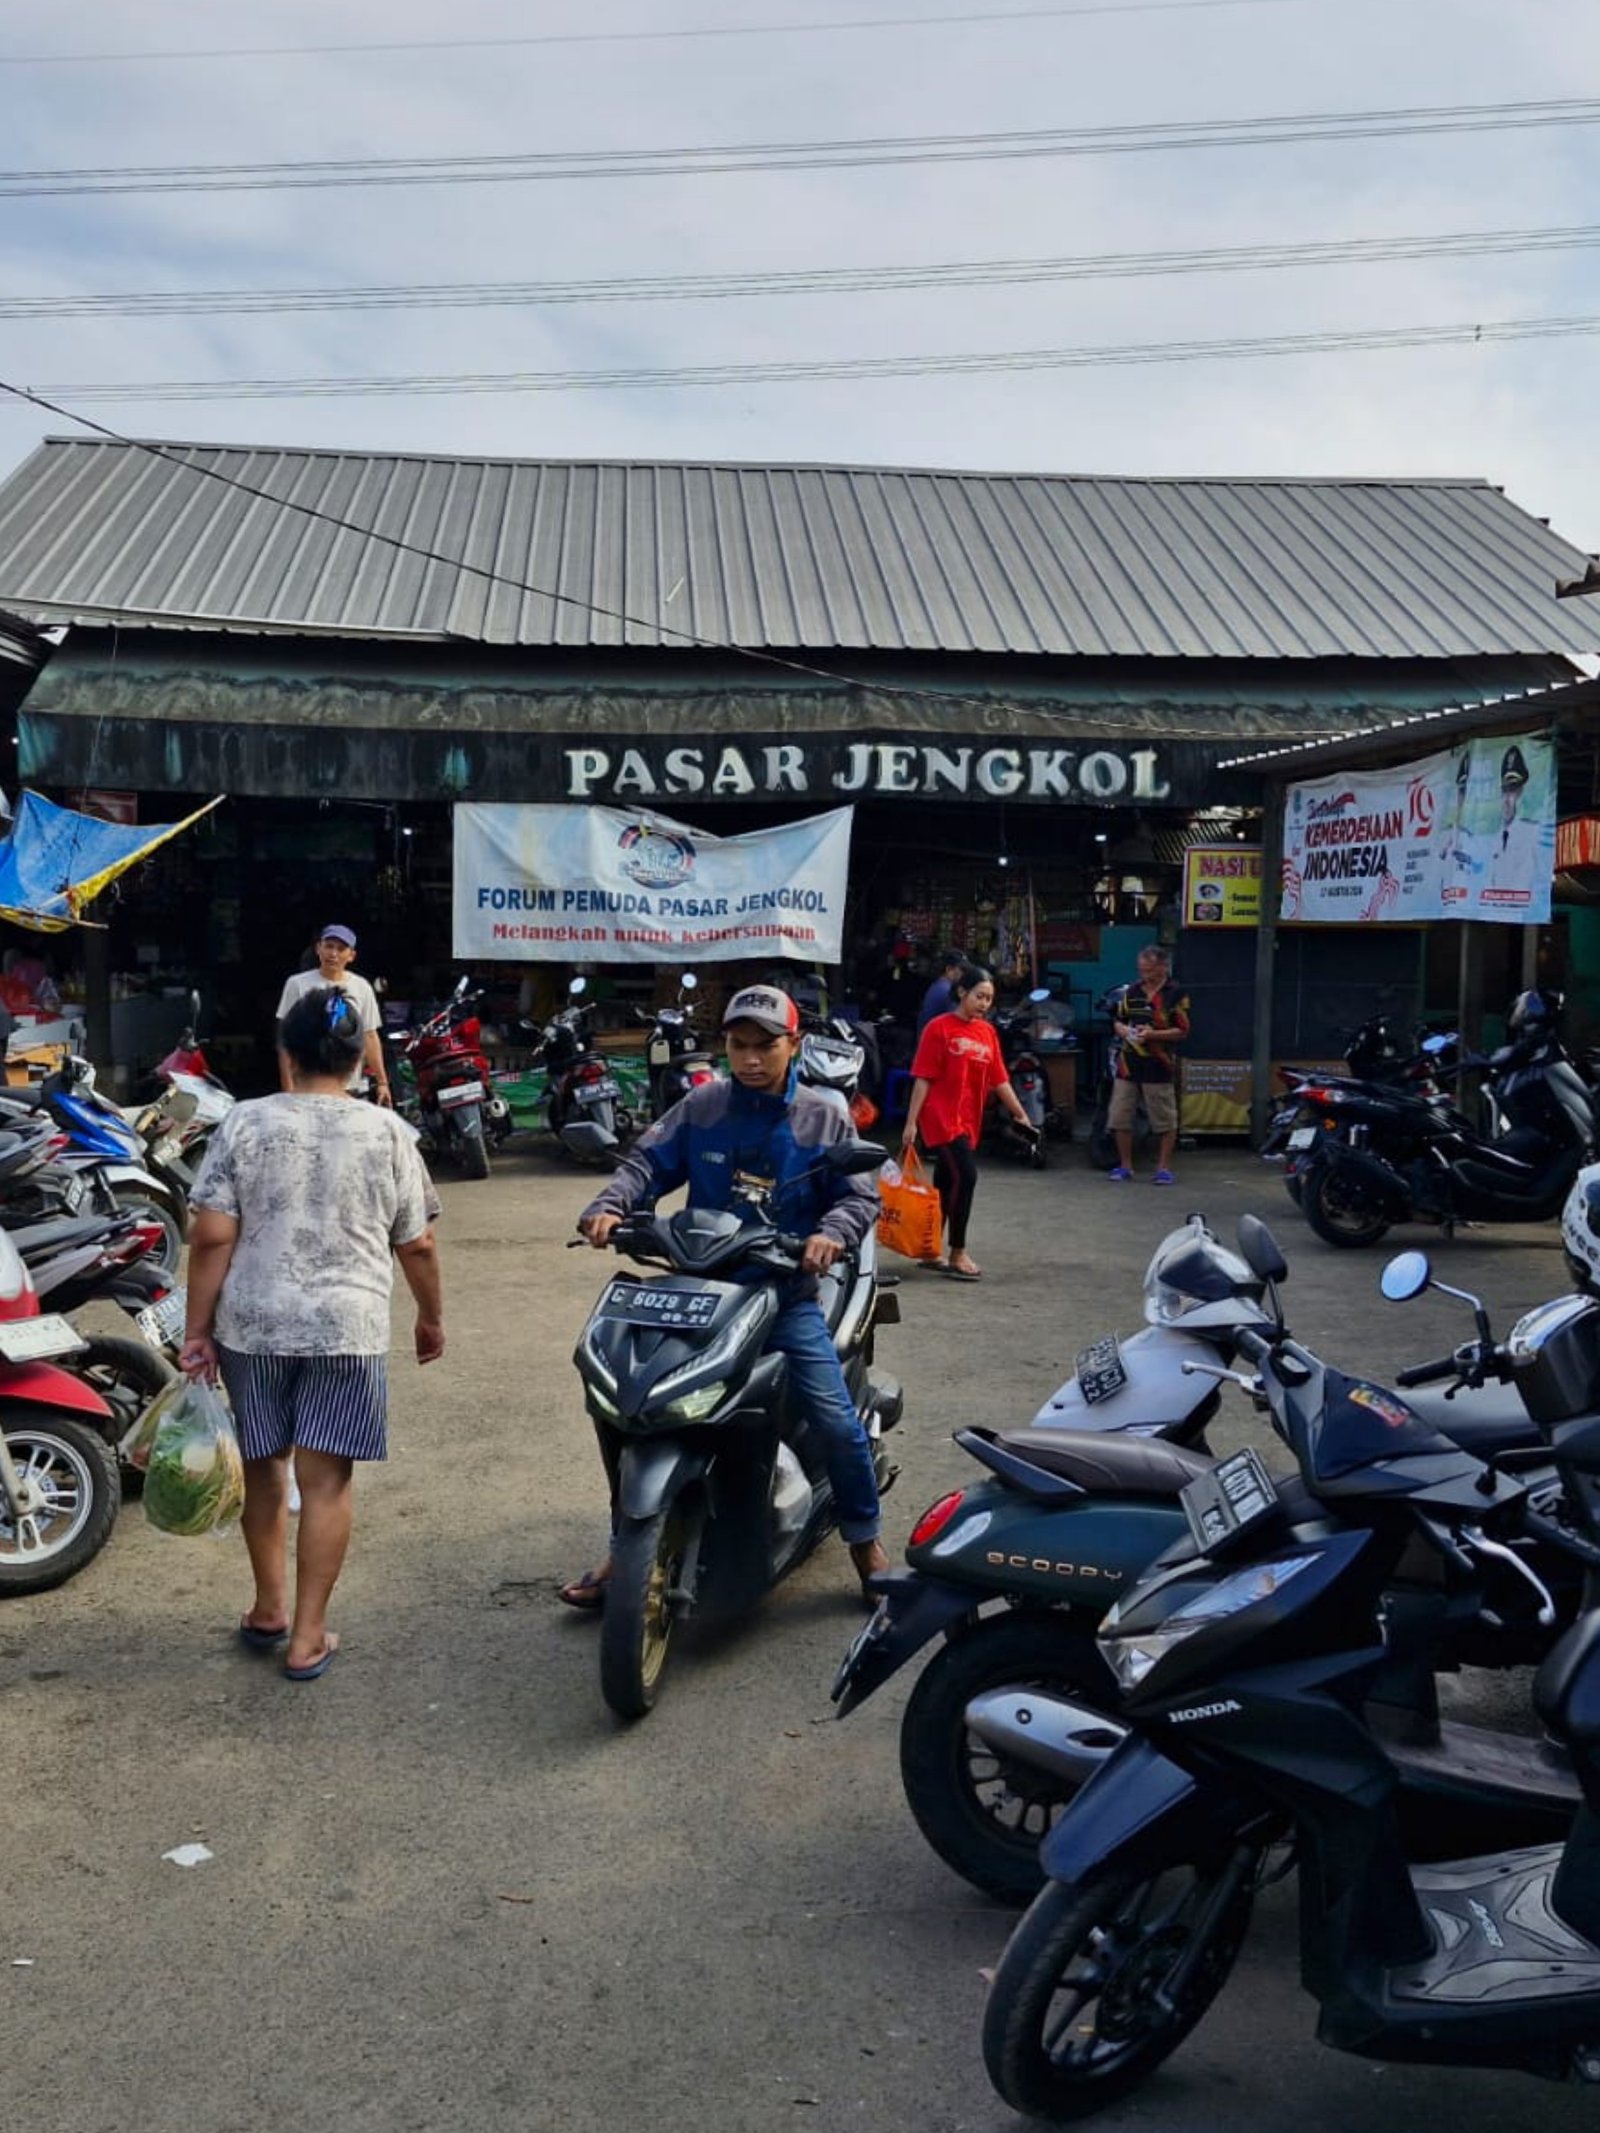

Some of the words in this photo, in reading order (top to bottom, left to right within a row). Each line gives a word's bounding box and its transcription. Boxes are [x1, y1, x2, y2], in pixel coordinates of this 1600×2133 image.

[565, 746, 808, 796] PASAR
[832, 744, 1170, 799] JENGKOL
[1305, 810, 1404, 849] KEMERDEKAAN
[1200, 856, 1246, 878] NASI
[1303, 845, 1389, 881] INDONESIA
[478, 887, 555, 911] FORUM
[563, 890, 651, 915] PEMUDA
[659, 898, 728, 917] PASAR
[736, 888, 827, 914] JENGKOL
[493, 923, 606, 943] Melangkah
[614, 927, 672, 944] untuk
[987, 1551, 1122, 1580] SCOOPY
[1168, 1699, 1242, 1723] HONDA
